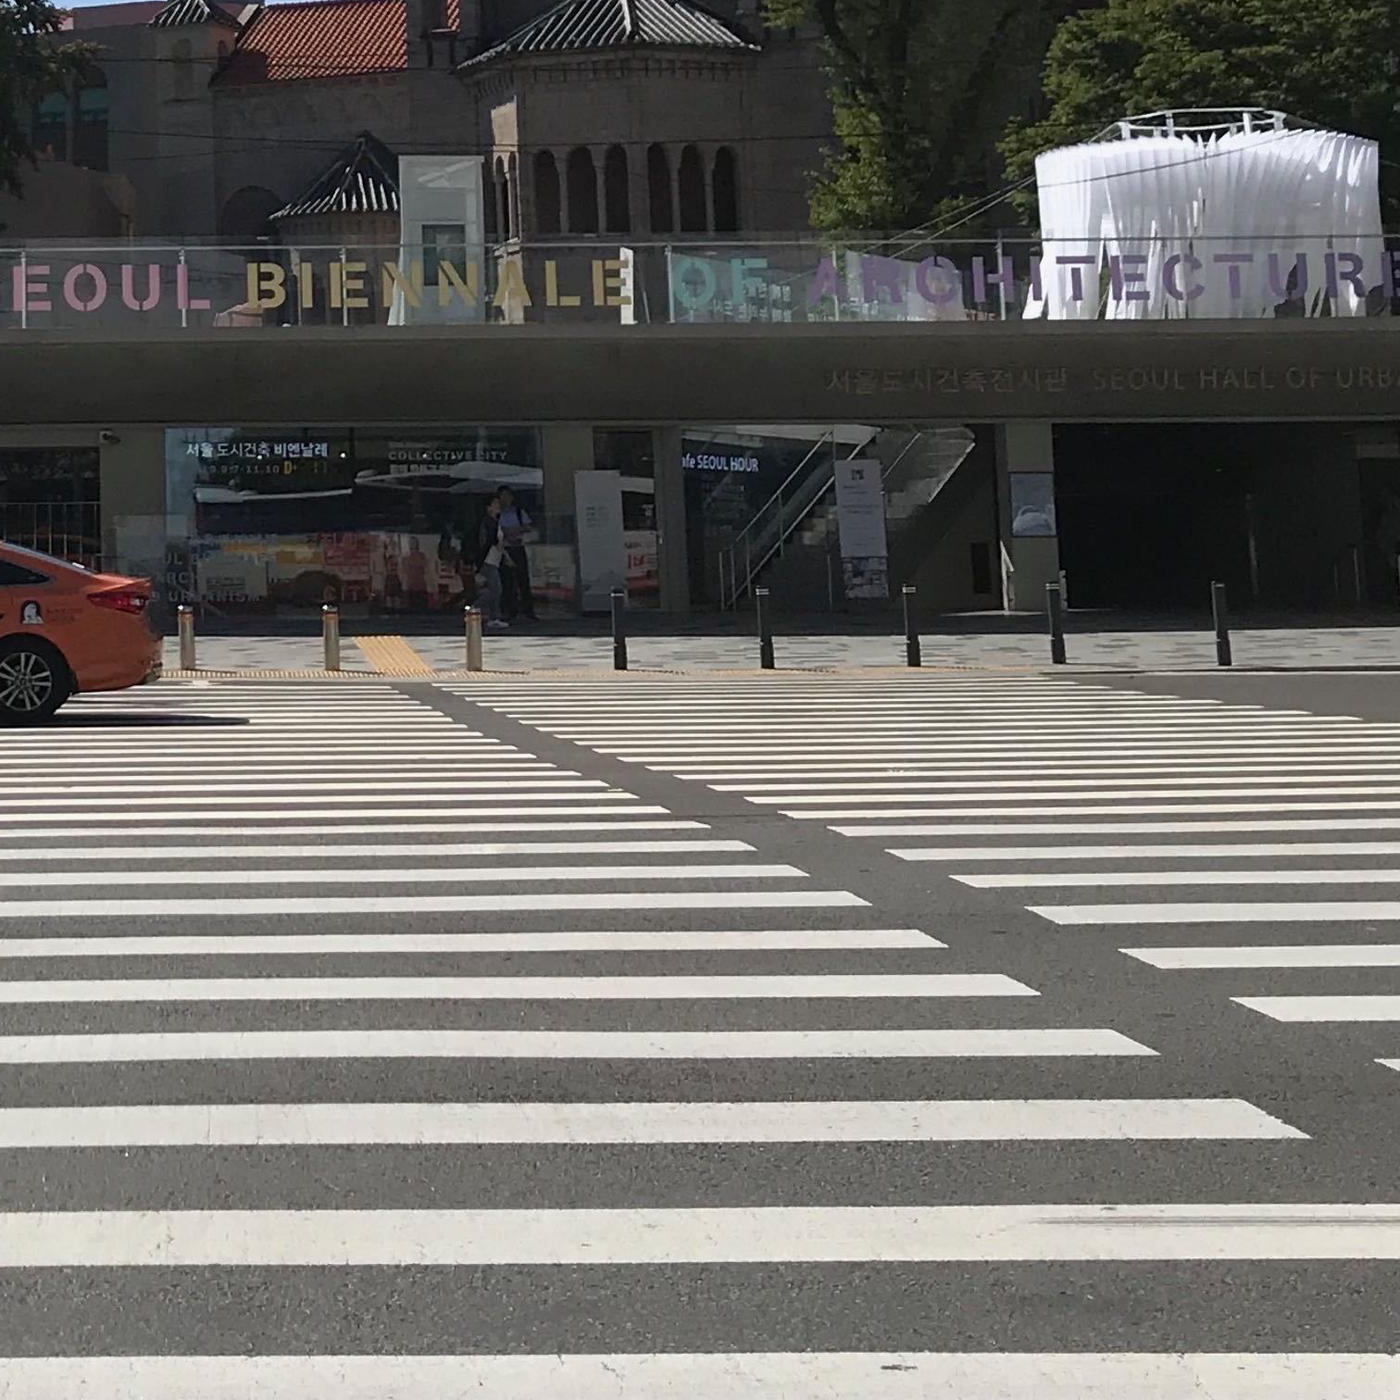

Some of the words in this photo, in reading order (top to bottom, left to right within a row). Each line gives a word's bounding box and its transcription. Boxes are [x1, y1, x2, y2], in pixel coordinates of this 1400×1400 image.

[247, 260, 632, 309] BIENNALE
[673, 257, 768, 308] OF
[1093, 367, 1186, 391] SEOUL
[1200, 366, 1275, 390] HALL
[1285, 365, 1325, 389] OF
[1336, 365, 1400, 389] URB
[185, 441, 213, 458] 서울
[217, 441, 270, 458] 도시건축
[274, 441, 328, 458] 비엔날레
[388, 450, 473, 461] COLLECTIVE
[696, 454, 729, 470] SEOUL
[730, 457, 760, 473] HOUR
